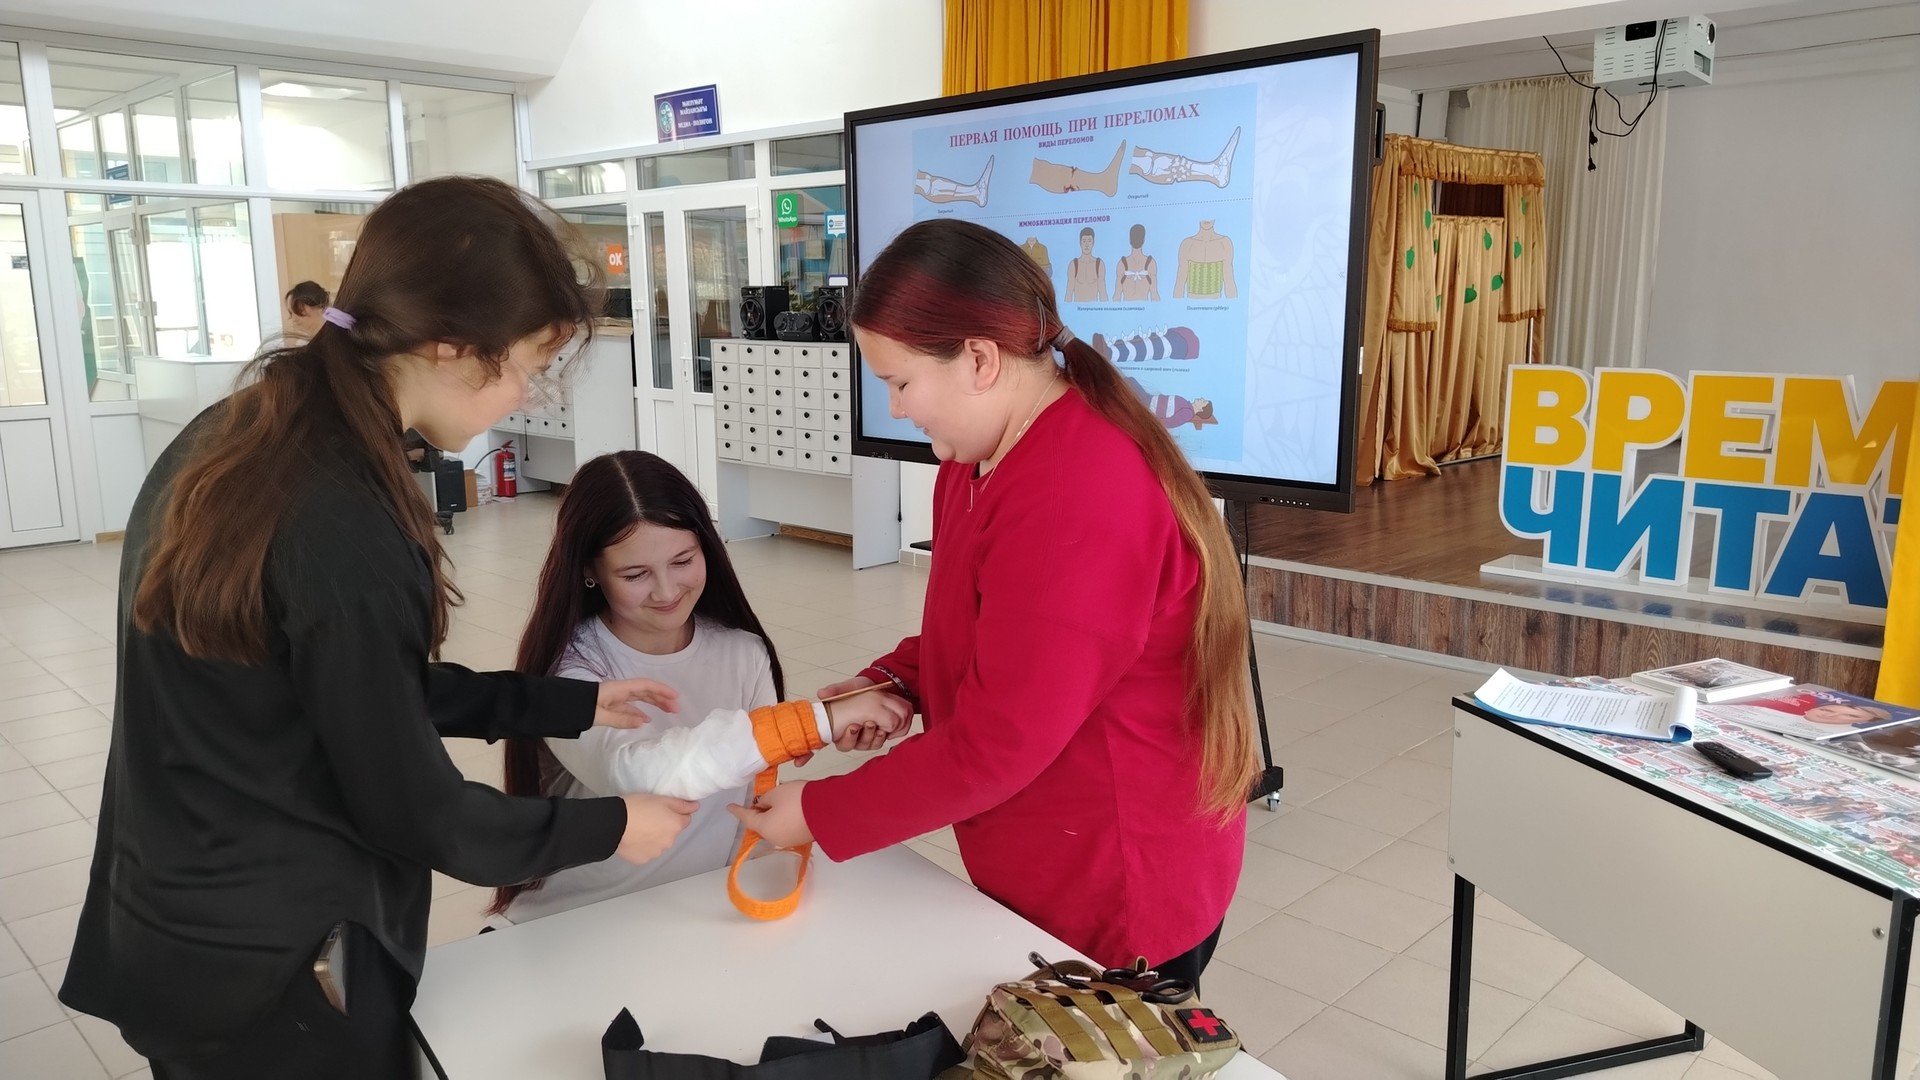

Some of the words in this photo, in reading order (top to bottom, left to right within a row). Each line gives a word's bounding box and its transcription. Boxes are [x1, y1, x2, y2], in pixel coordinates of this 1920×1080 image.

[949, 130, 998, 148] ПЕРВАЯ
[1003, 122, 1063, 141] ПОМОЩЬ
[1068, 117, 1098, 133] ПРИ
[1103, 103, 1200, 129] ПЕРЕЛОМАХ
[1038, 140, 1057, 149] ВИДЫ
[1057, 135, 1094, 146] ПЕРЕЛОМОВ
[1018, 217, 1072, 228] ИММОБИЛИЗАЦИЯ
[1072, 215, 1111, 224] ПЕРЕЛОМОВ
[1500, 462, 1901, 610] ЧИТА
